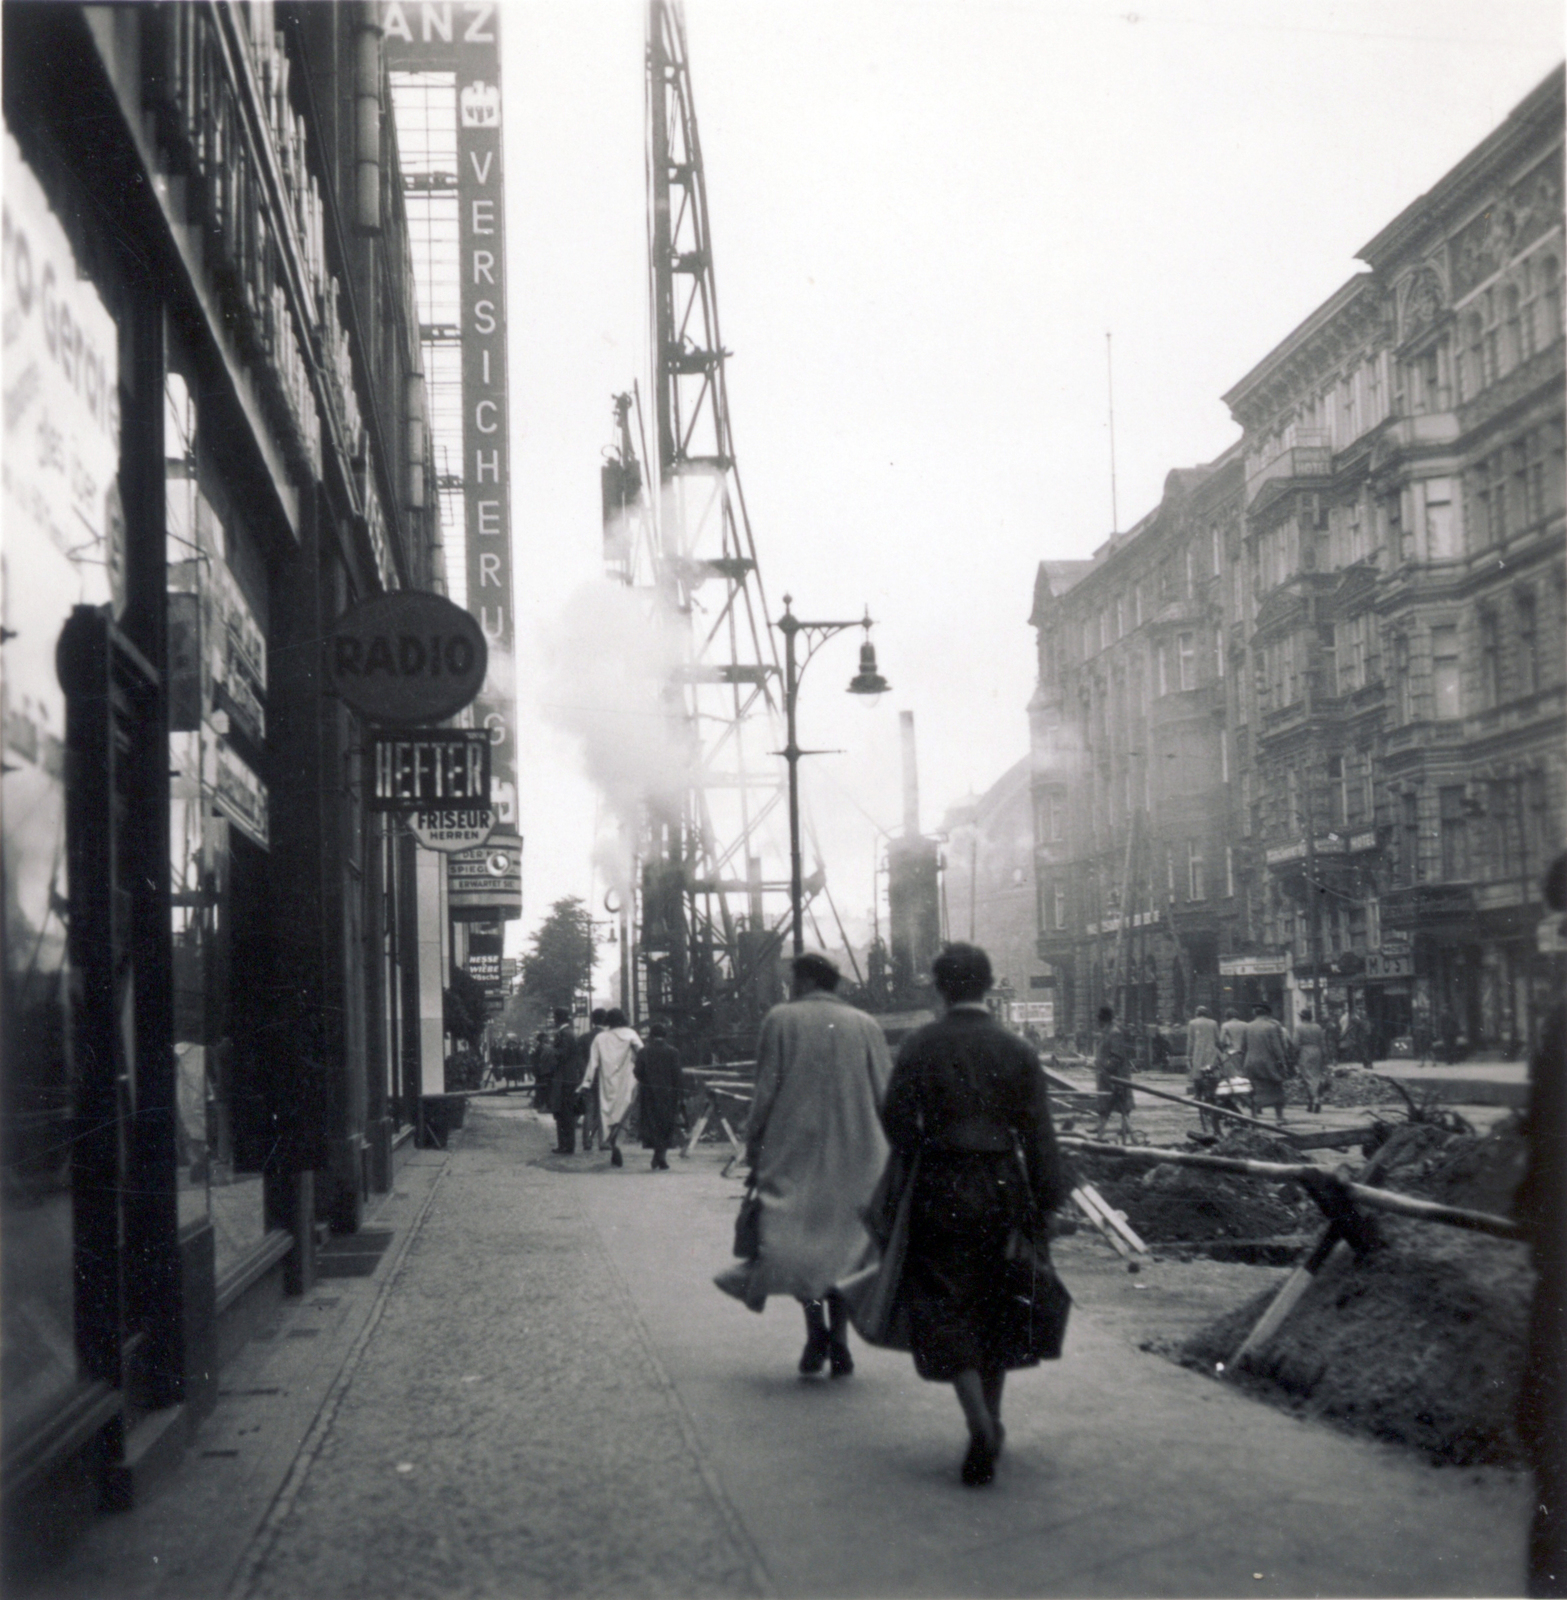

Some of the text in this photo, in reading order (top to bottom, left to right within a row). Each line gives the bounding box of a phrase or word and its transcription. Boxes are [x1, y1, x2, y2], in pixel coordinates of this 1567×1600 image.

[381, 2, 494, 43] ANZ
[470, 151, 506, 746] VERSICHERUG
[335, 634, 475, 677] RADIO
[376, 742, 482, 797] HEFTER
[417, 811, 490, 830] FRISEUR
[430, 830, 480, 840] HERREN
